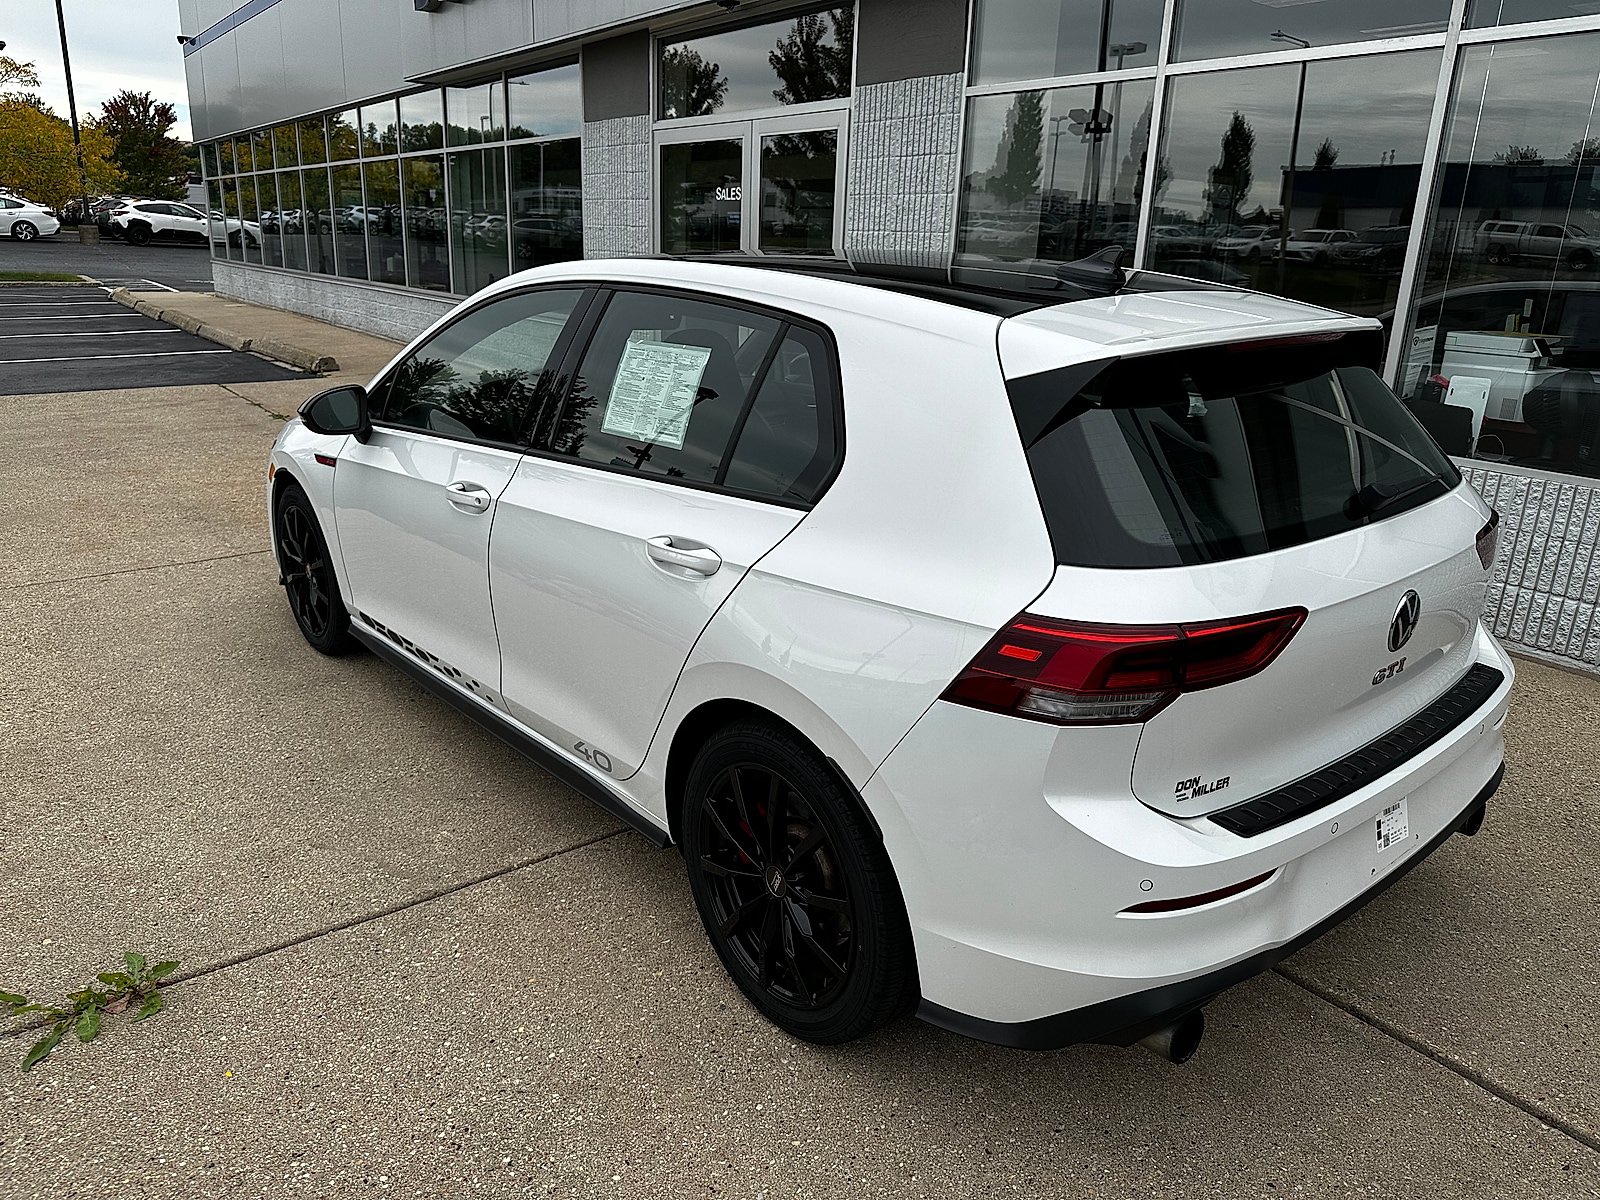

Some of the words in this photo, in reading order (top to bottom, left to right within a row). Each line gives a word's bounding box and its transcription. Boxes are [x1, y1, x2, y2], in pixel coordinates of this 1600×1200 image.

[715, 186, 742, 201] SALES
[1372, 656, 1407, 686] GTI
[573, 741, 612, 773] 40
[1174, 775, 1201, 793] DON
[1191, 776, 1230, 799] MILLER
